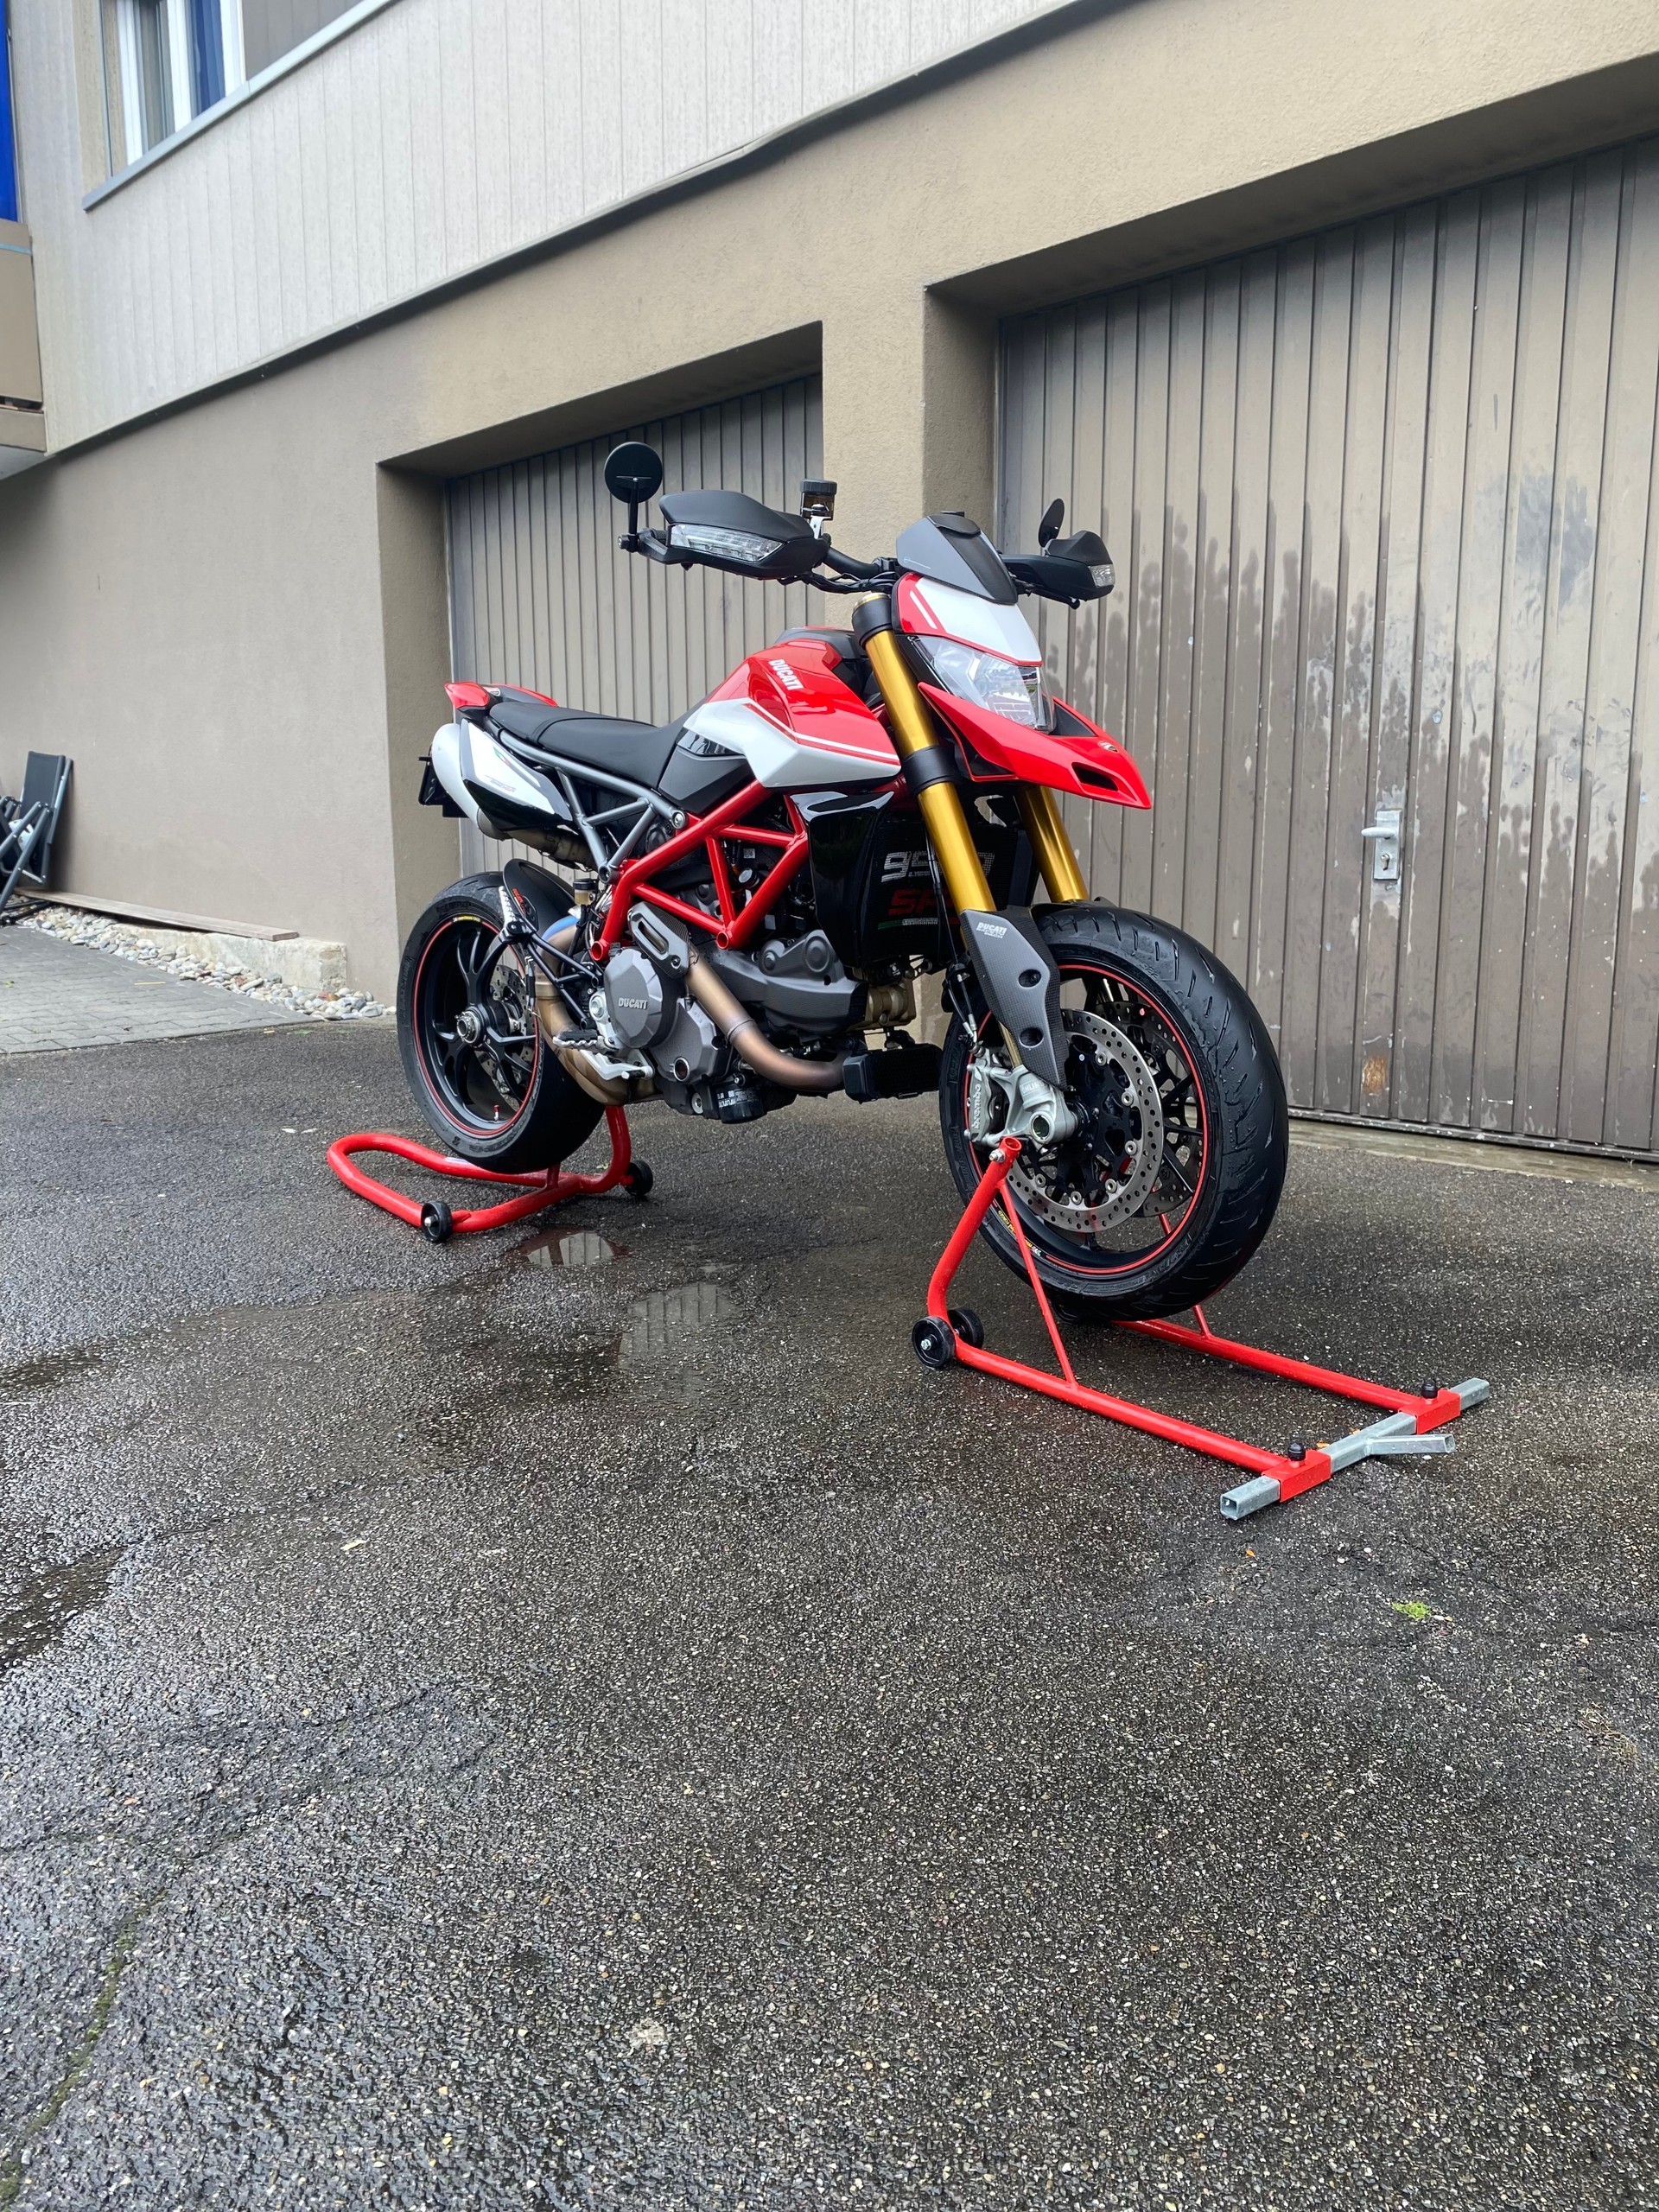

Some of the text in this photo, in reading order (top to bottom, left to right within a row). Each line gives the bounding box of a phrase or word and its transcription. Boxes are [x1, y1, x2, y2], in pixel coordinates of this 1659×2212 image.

[768, 658, 804, 690] DUCATI
[977, 922, 1007, 935] DUCATI
[618, 997, 648, 1010] DUCATI
[972, 1084, 982, 1129] brembo
